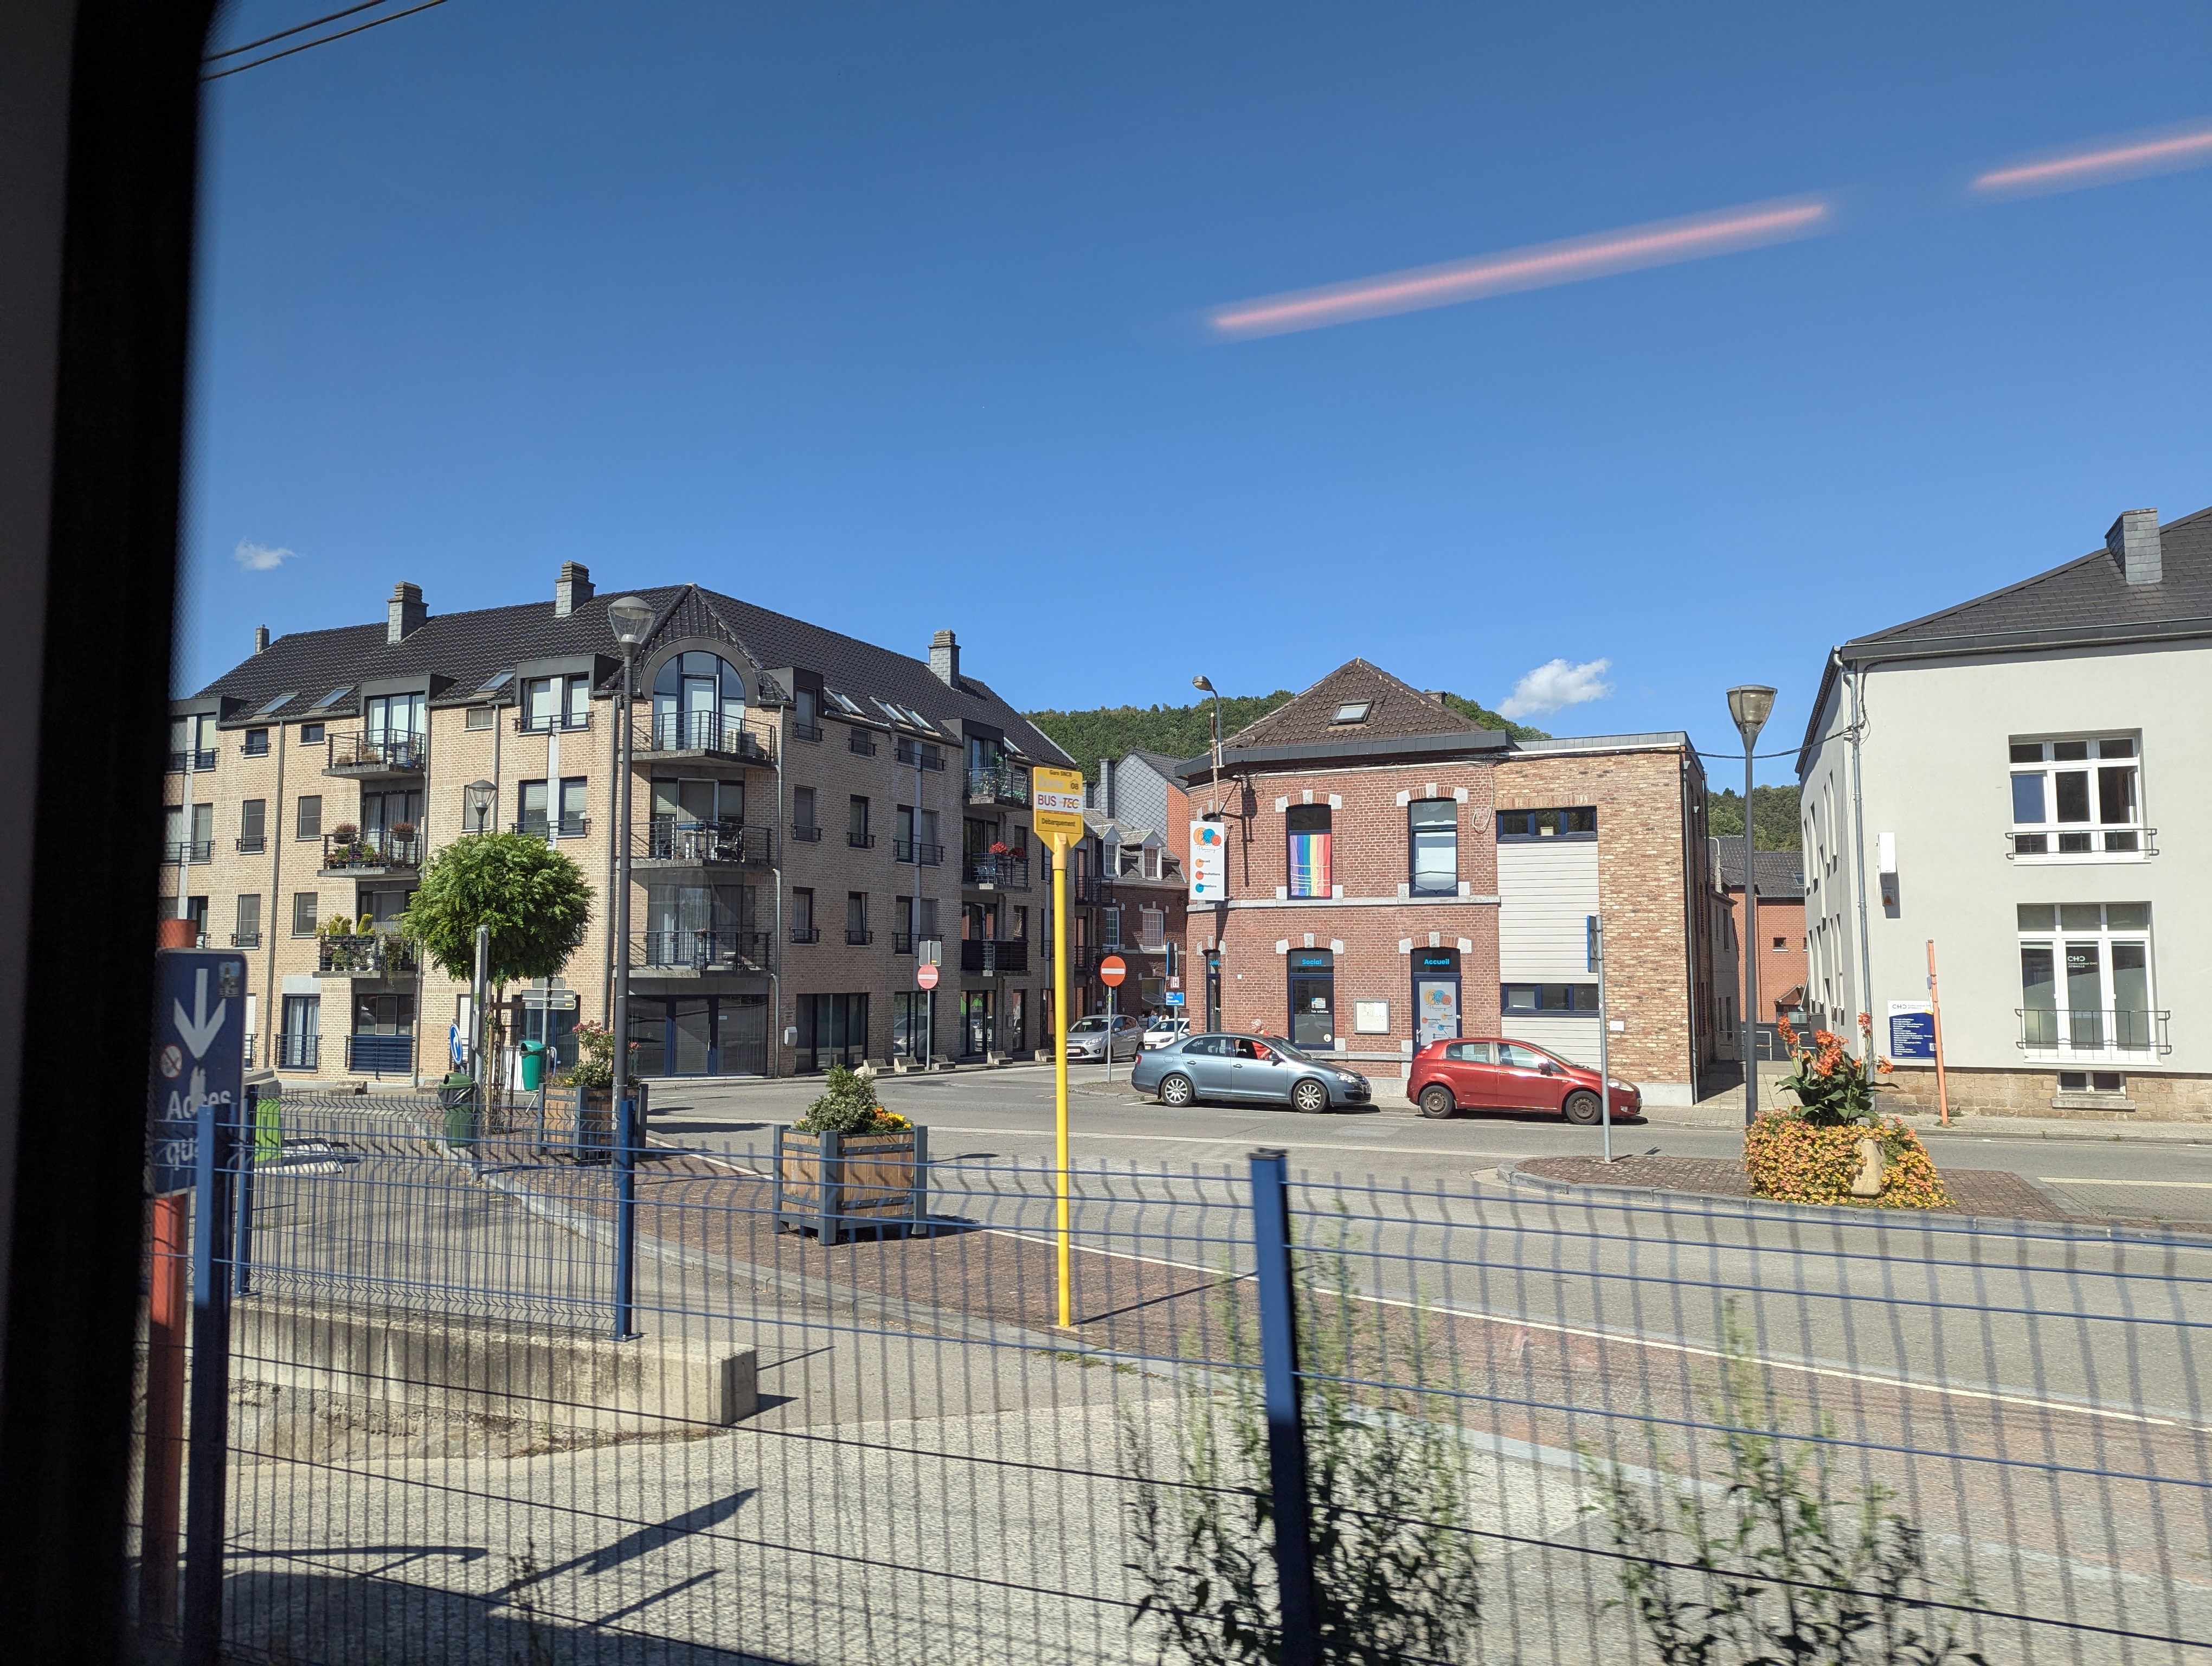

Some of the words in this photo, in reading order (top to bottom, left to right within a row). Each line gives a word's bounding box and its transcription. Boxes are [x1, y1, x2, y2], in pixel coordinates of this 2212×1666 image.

[1038, 794, 1057, 806] BUS
[1062, 797, 1079, 809] TEC
[1174, 978, 1178, 986] H
